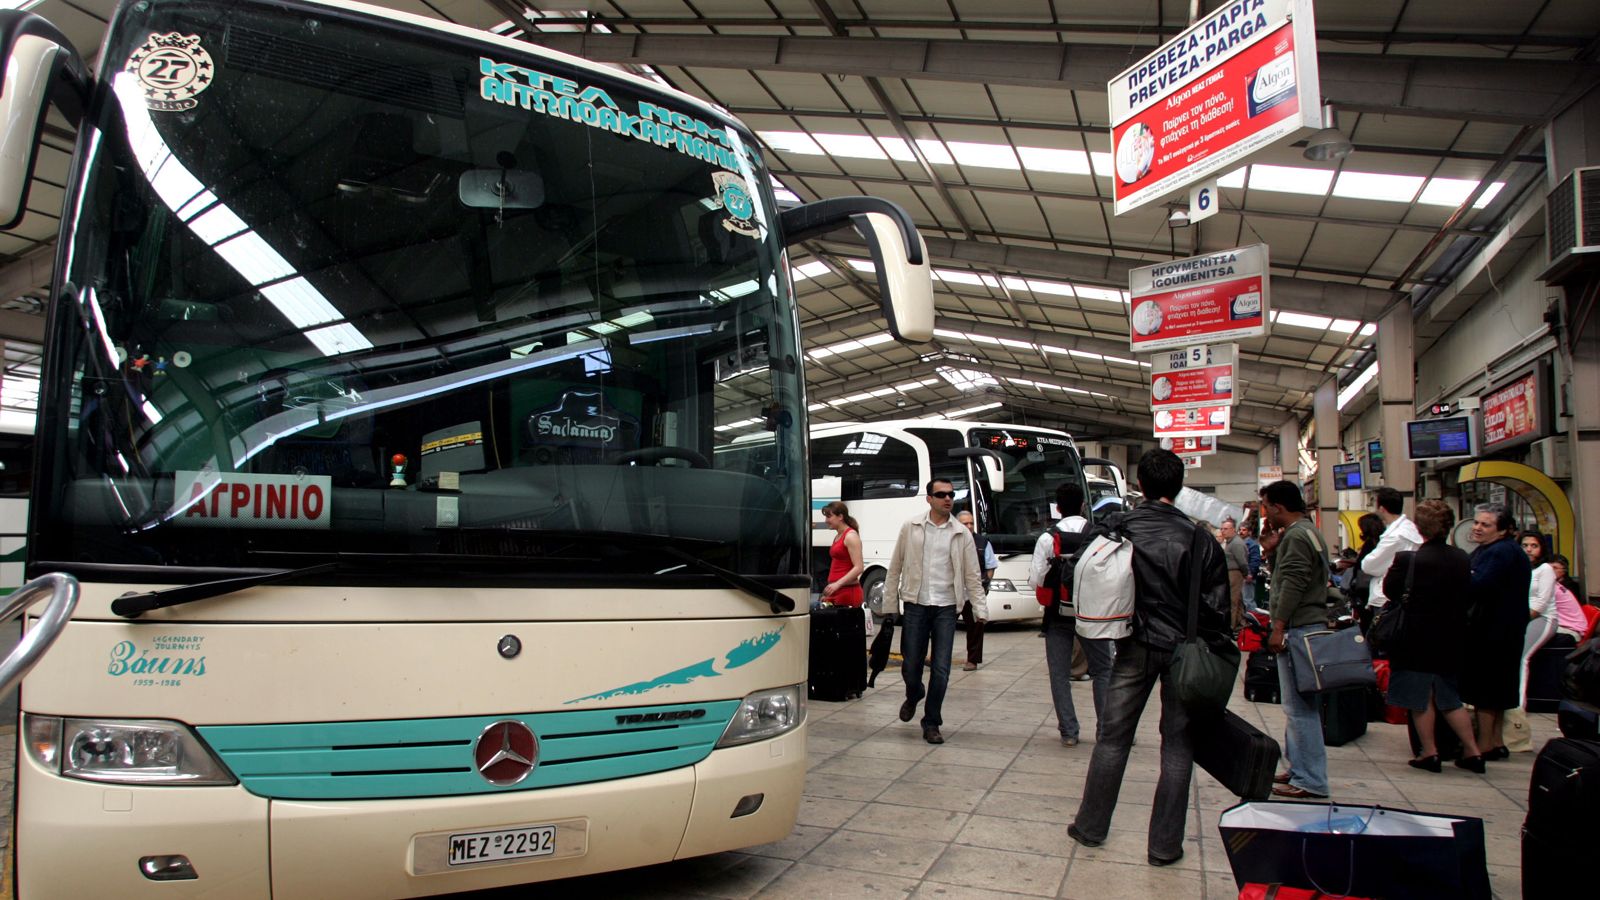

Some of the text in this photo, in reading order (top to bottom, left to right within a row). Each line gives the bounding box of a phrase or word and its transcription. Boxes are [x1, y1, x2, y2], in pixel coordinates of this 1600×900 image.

[1128, 0, 1265, 90] ΠΡΕΒΕΖΑ-ΠΑΡΓΑ
[146, 58, 190, 80] 27
[1129, 12, 1267, 109] PREVEZA-PARGA
[479, 57, 619, 110] ΚΤΕΛ
[1258, 67, 1291, 91] Algon
[1166, 89, 1191, 110] Algon
[1162, 92, 1227, 132] Παίρνει τον πόνο,
[1190, 119, 1200, 132] τη
[1200, 97, 1234, 125] διάθεση!
[728, 194, 745, 211] 27
[1198, 188, 1210, 210] 6
[1152, 253, 1237, 277] ΗΓΟΥΜΕΝΙΤΣΑ
[1152, 266, 1235, 288] IGOUMENITSA
[1193, 348, 1201, 361] 5
[1188, 411, 1194, 420] 4
[185, 482, 324, 520] ΑΓΡΙΝΙΟ
